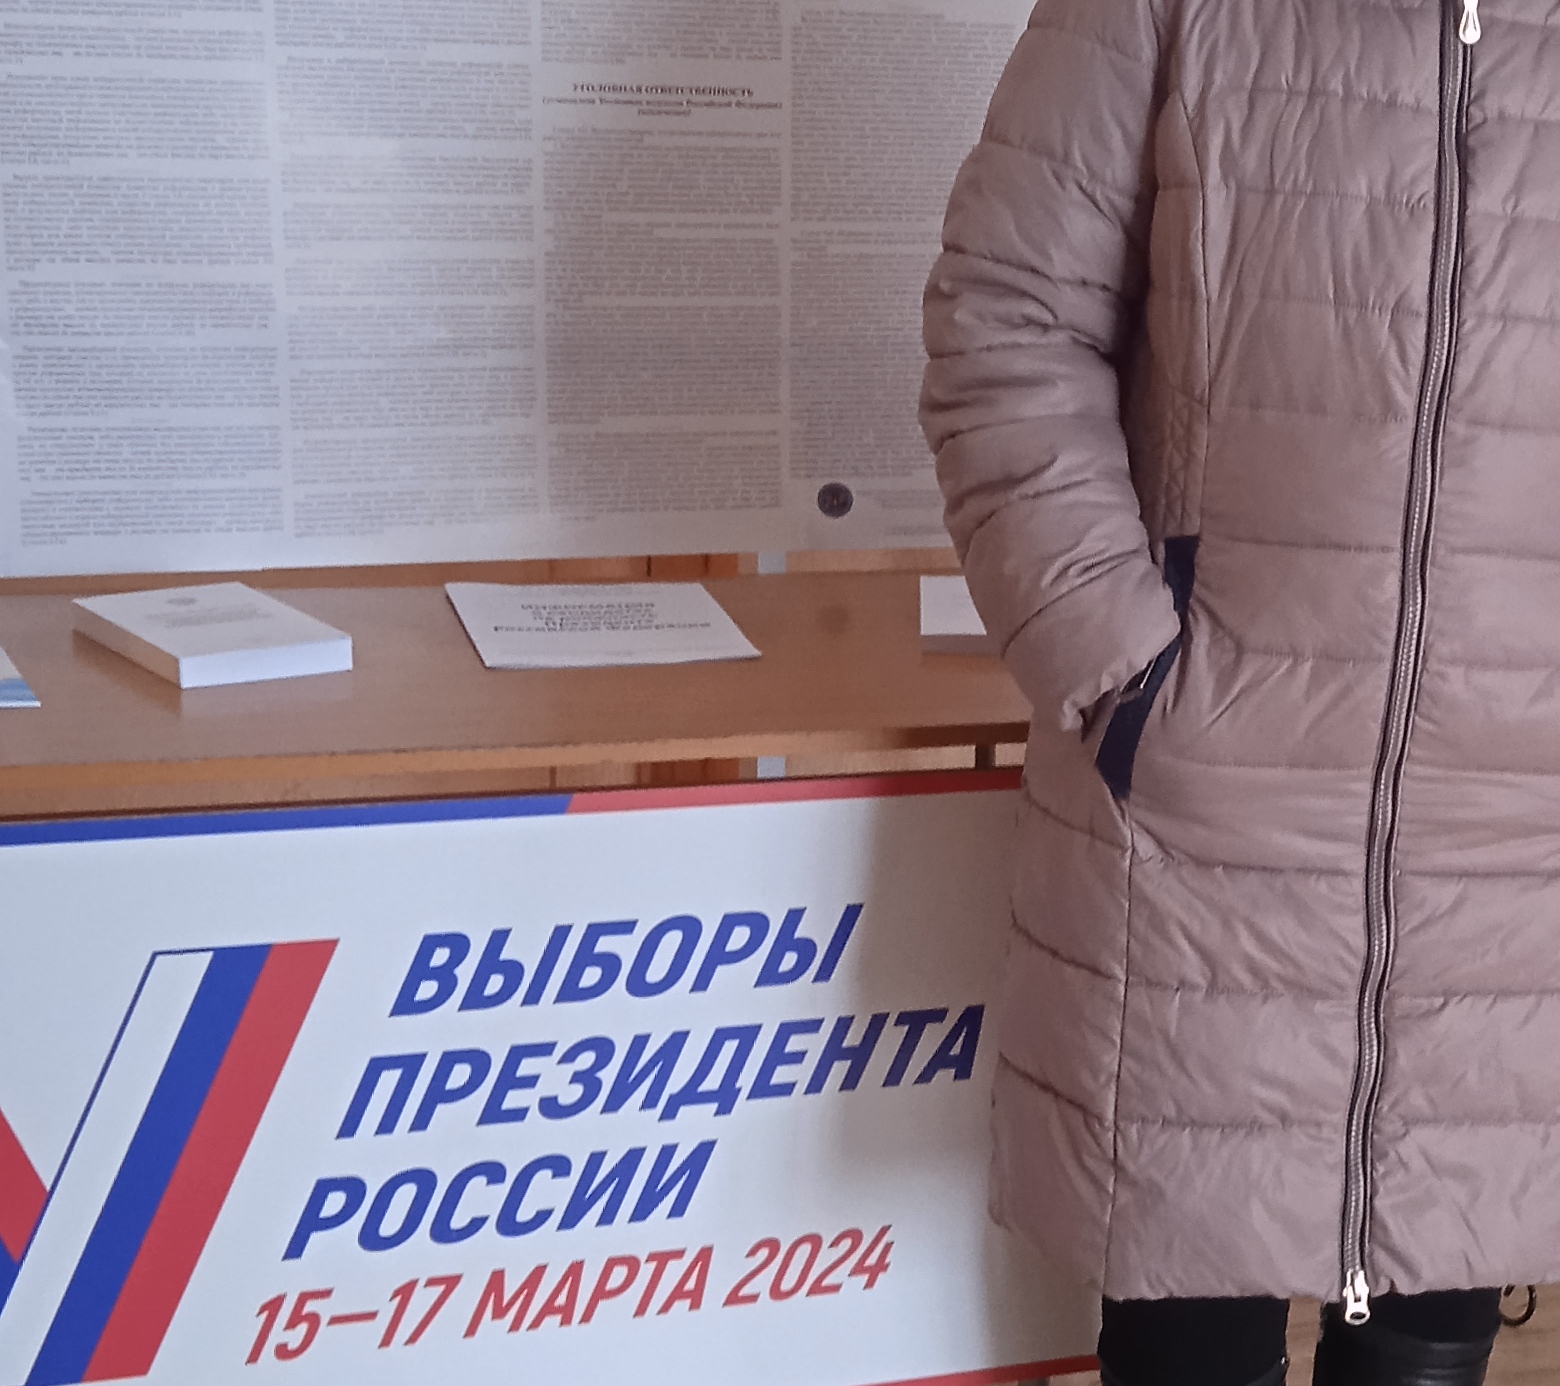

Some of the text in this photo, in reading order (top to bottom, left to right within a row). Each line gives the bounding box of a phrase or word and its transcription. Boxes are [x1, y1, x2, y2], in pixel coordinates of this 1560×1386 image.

[389, 904, 862, 1018] ВЫБОРЫ
[335, 1004, 985, 1139] ПРЕЗИДЕНТА
[282, 1139, 716, 1262] РОССИИ
[464, 1243, 713, 1340] МАРТА
[722, 1224, 896, 1308] 2024
